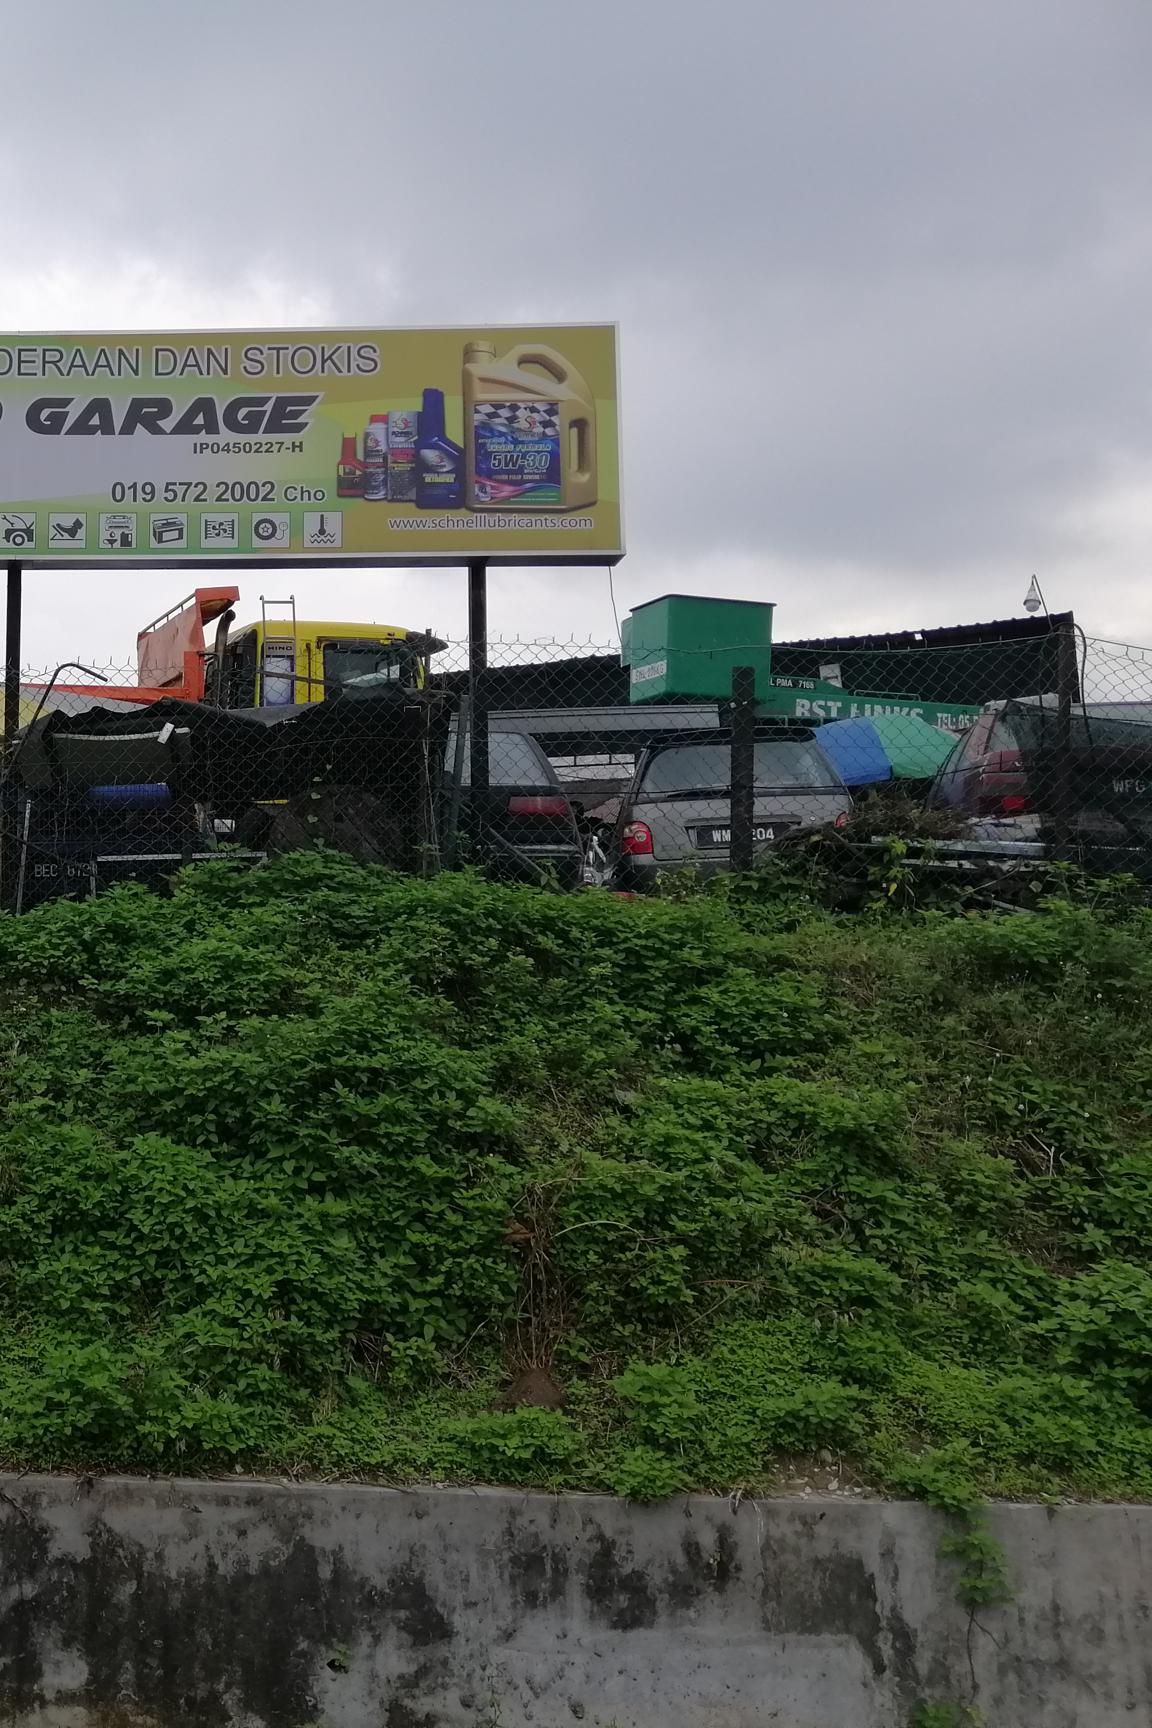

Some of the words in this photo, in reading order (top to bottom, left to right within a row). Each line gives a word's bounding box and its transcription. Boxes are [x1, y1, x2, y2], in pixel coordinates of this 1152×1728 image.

[153, 346, 230, 377] DAN
[242, 344, 380, 376] STOKIS
[25, 394, 320, 436] GARAGE
[192, 441, 304, 455] IP0450227-H
[491, 452, 550, 470] 5W-30
[110, 481, 156, 504] 019
[162, 481, 209, 504] 572
[214, 480, 277, 503] 2002
[283, 485, 327, 502] Cho
[388, 514, 594, 530] www.schnelllubricants.com
